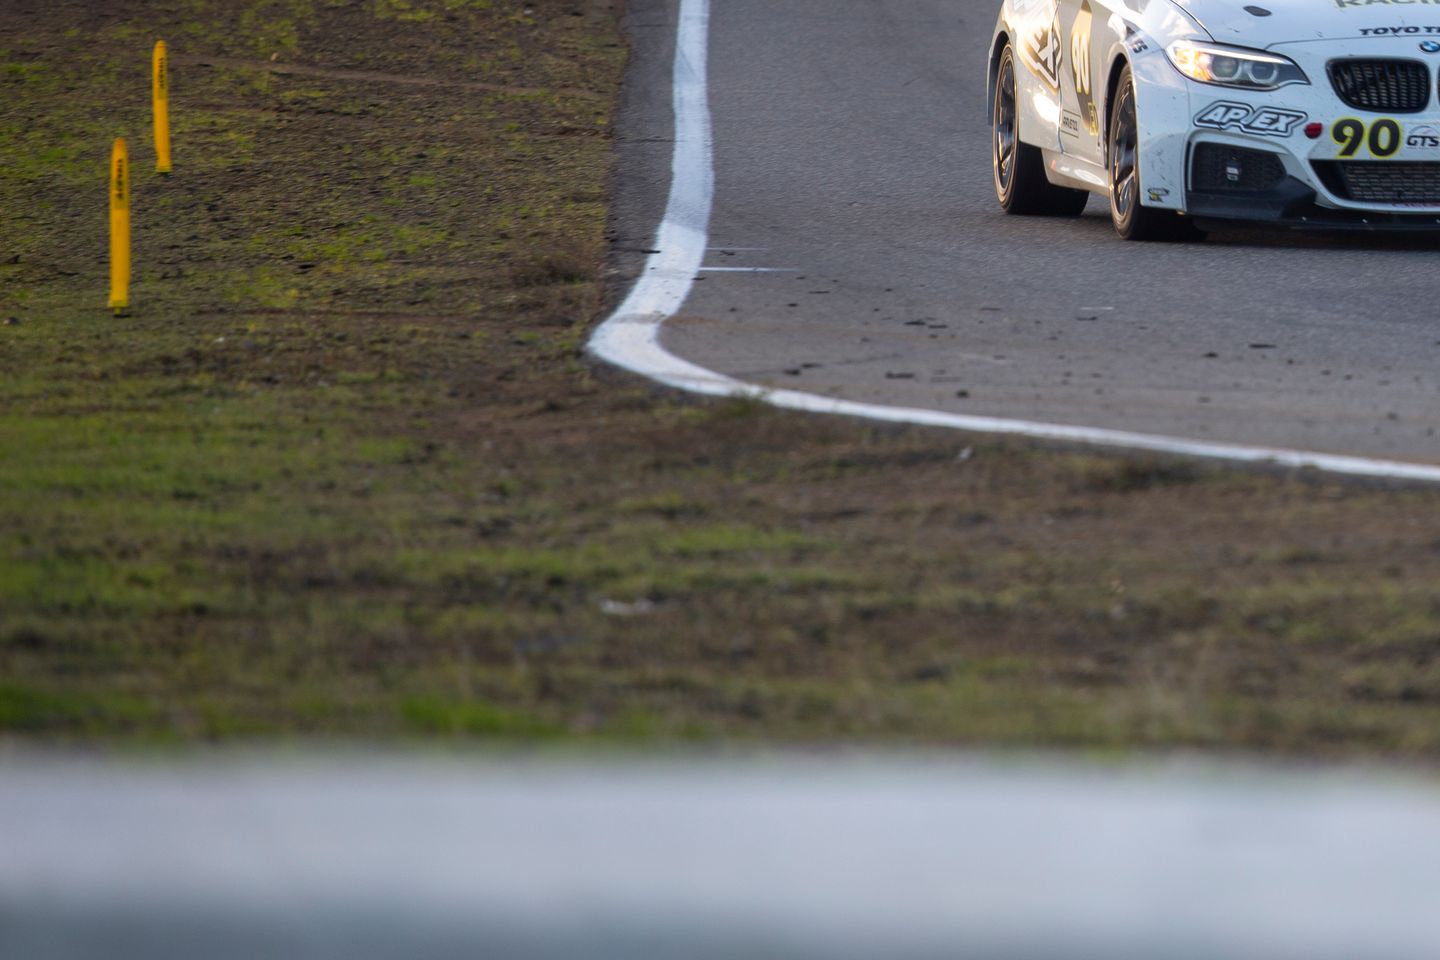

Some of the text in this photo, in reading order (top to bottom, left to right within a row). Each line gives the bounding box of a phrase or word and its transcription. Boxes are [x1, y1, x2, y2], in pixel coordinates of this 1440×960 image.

[1359, 25, 1420, 36] TOYO
[1200, 104, 1301, 133] APEX
[1332, 118, 1401, 157] 90
[1406, 134, 1440, 147] GTS
